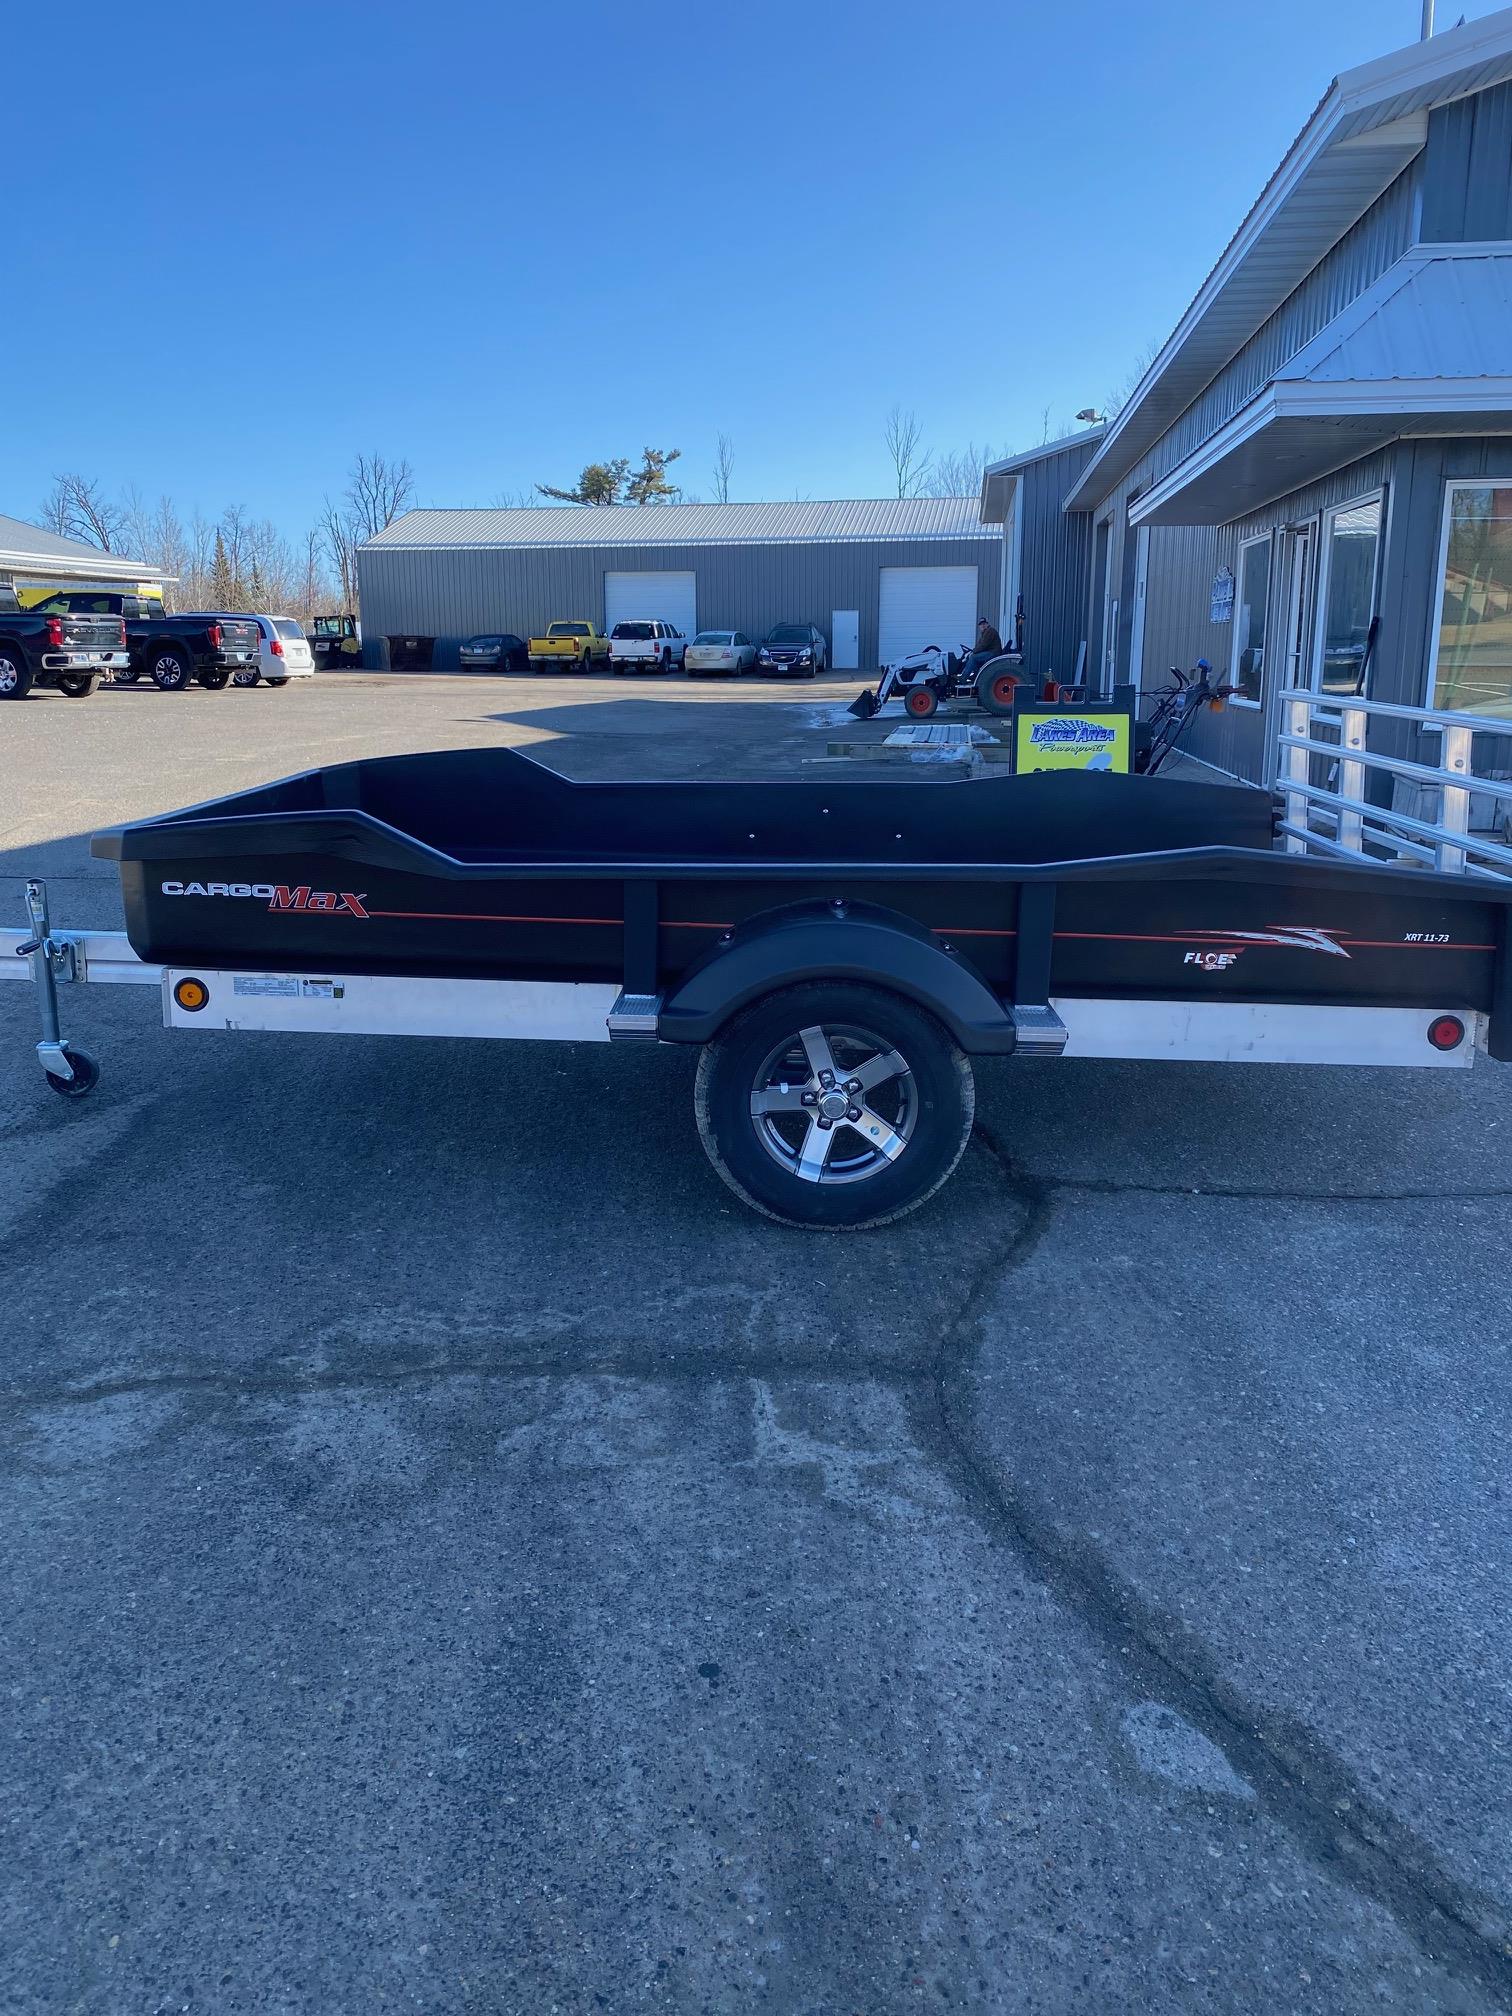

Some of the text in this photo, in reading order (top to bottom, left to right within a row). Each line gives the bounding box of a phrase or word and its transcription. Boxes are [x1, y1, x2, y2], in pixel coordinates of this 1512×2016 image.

[1030, 724, 1114, 742] LAKES AREA
[1404, 932, 1450, 943] XRT 11-73
[1183, 952, 1236, 965] FLOE
